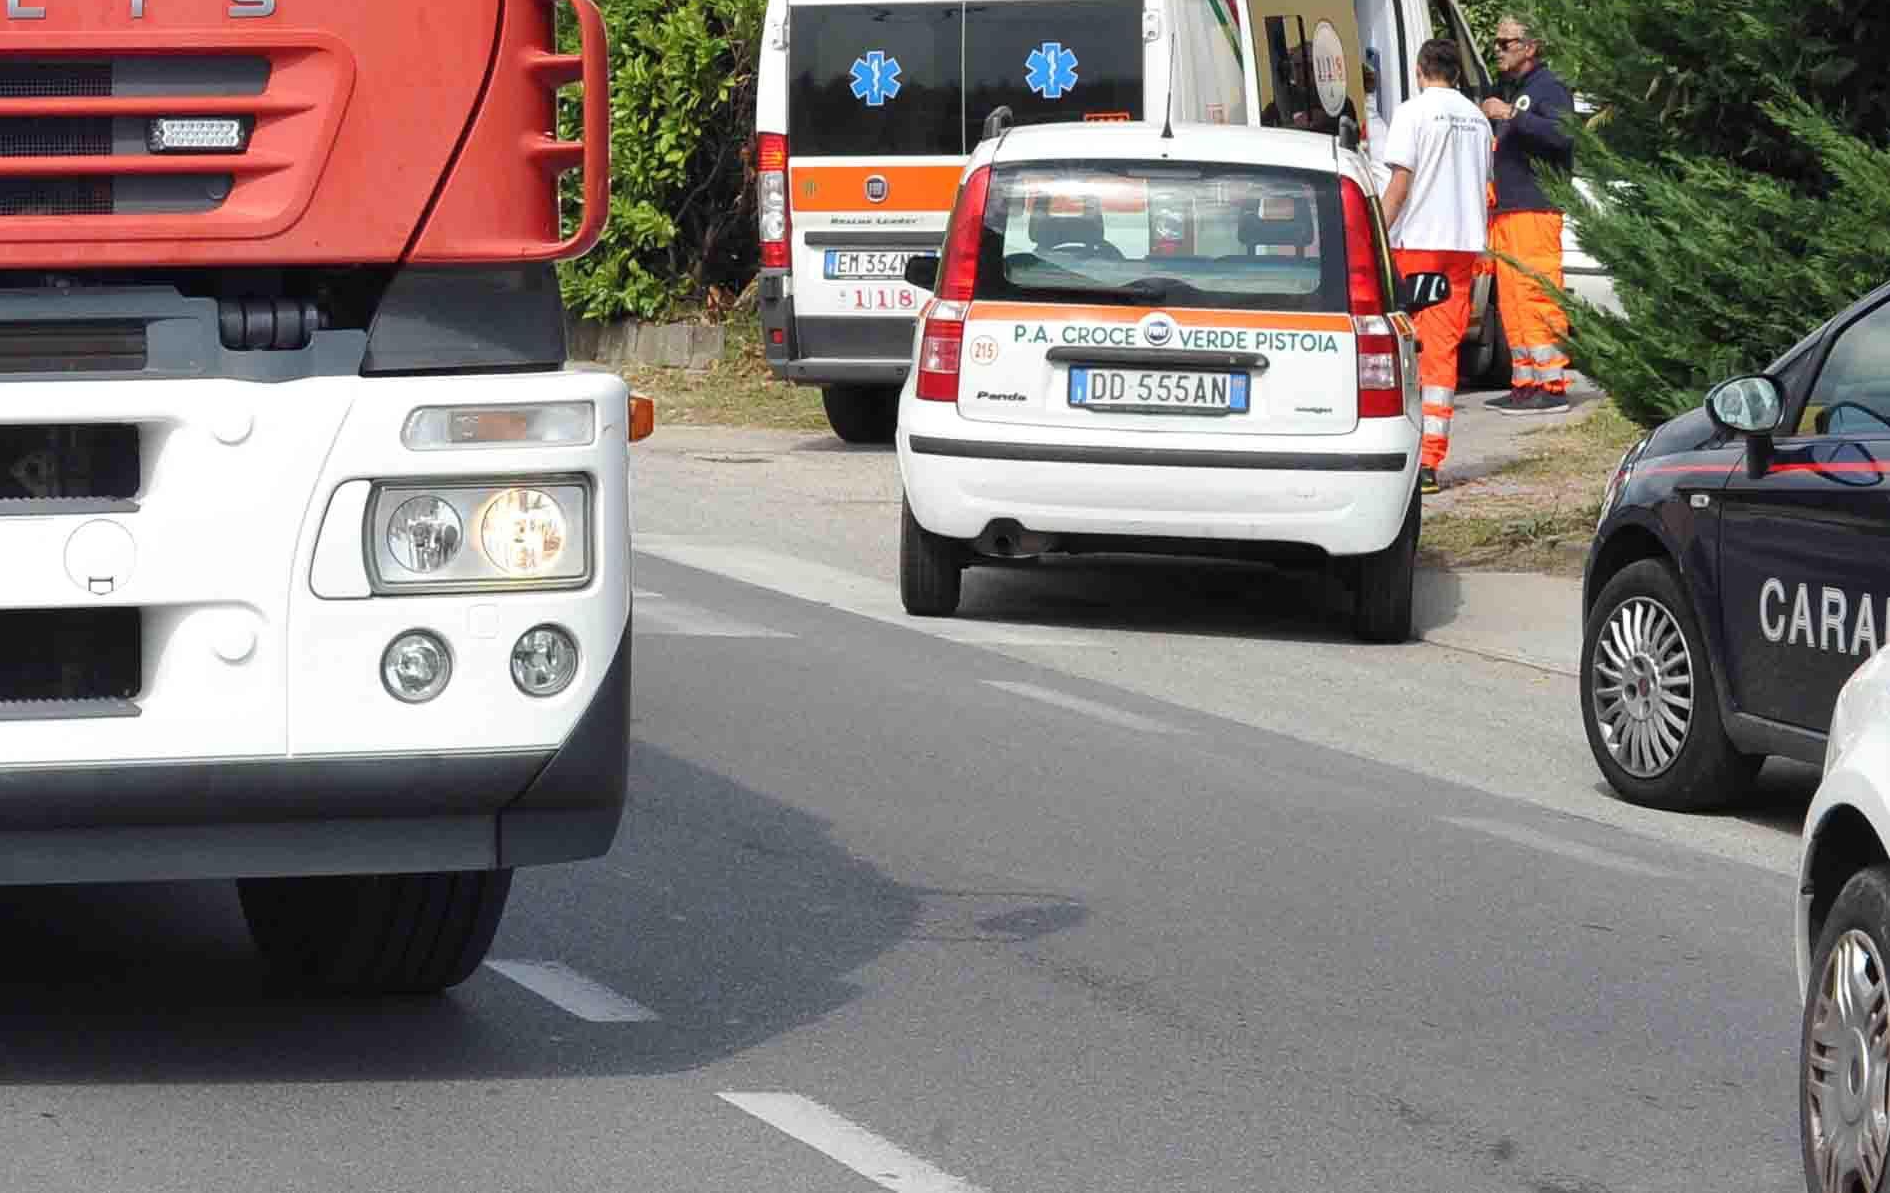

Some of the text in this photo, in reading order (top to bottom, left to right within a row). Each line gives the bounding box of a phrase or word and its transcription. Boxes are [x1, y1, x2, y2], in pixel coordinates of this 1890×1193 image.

[837, 254, 859, 273] EM
[1014, 324, 1339, 353] P.A. CROCE VERDE PISTOIA
[975, 342, 994, 359] 215
[976, 390, 1027, 402] Panda
[1091, 372, 1227, 405] DD 555AN
